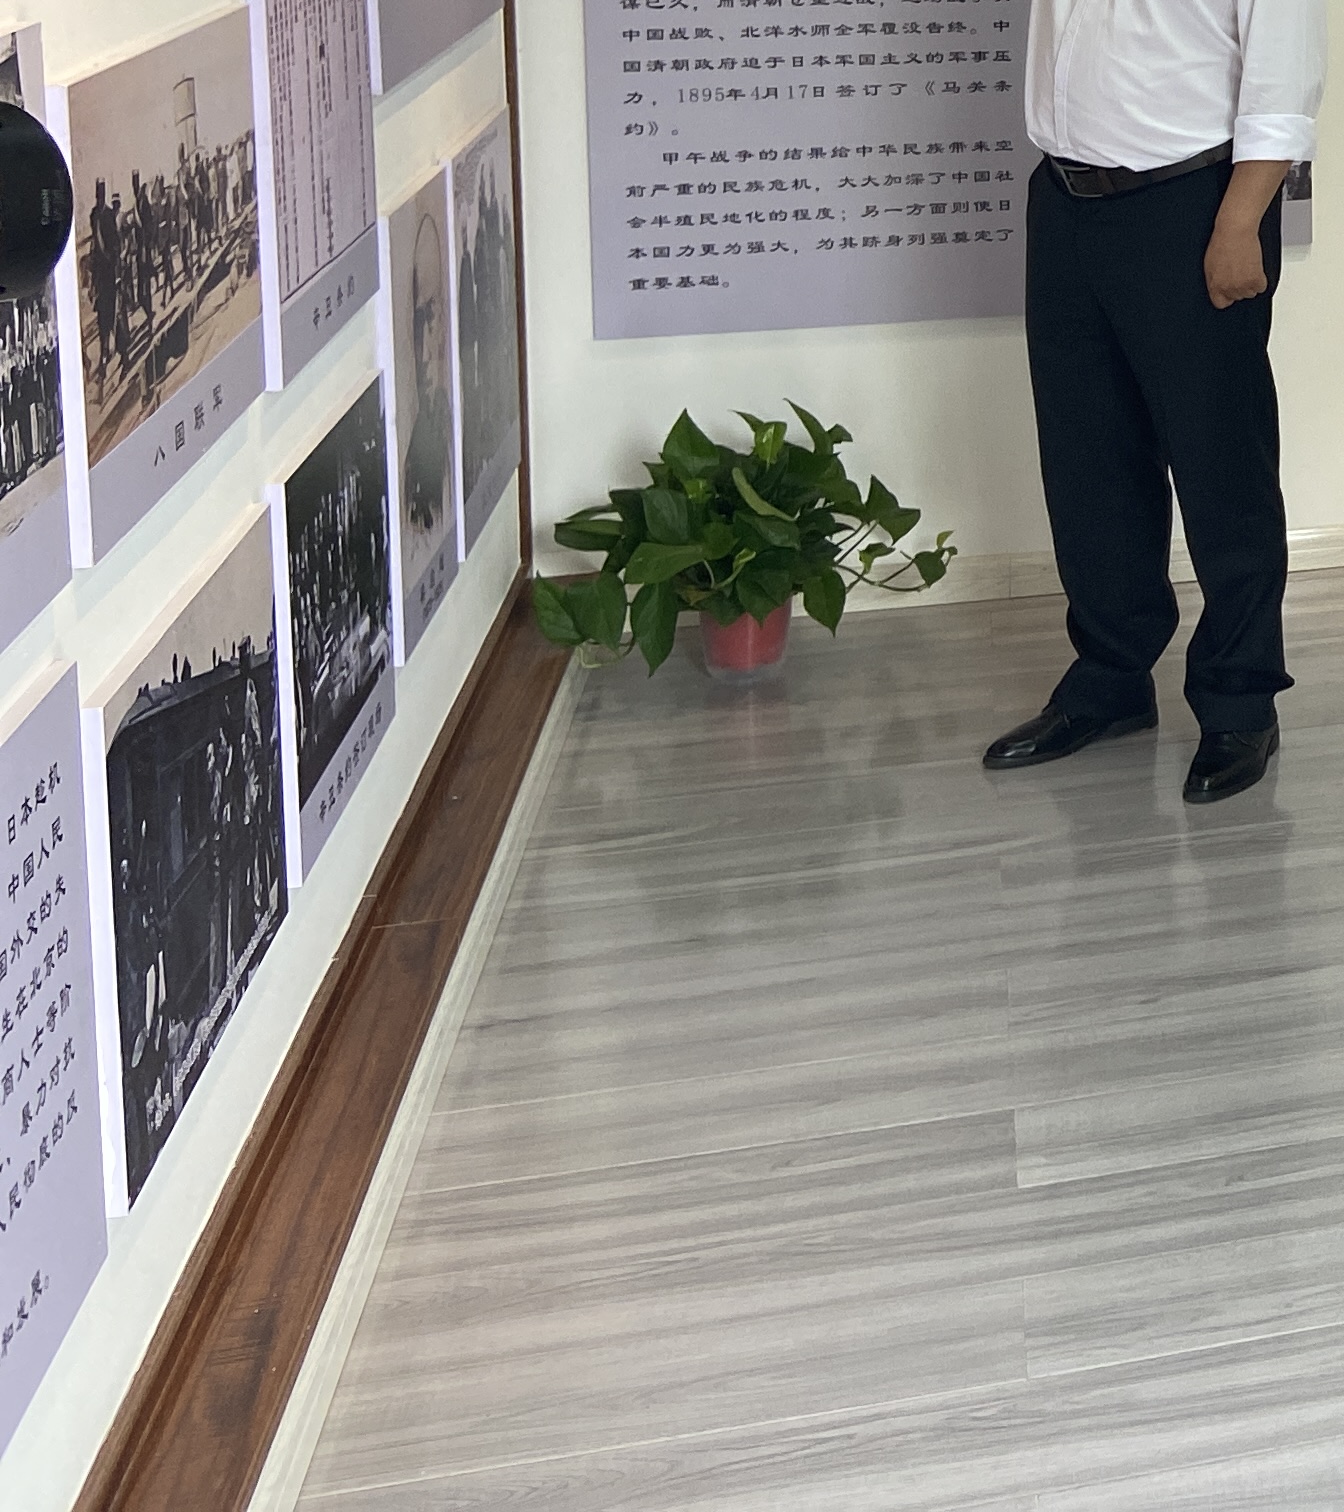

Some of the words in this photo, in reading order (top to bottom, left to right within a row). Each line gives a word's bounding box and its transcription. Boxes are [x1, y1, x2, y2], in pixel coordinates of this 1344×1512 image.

[154, 383, 223, 467] 八国联军
[7, 815, 64, 904] 中国人民
